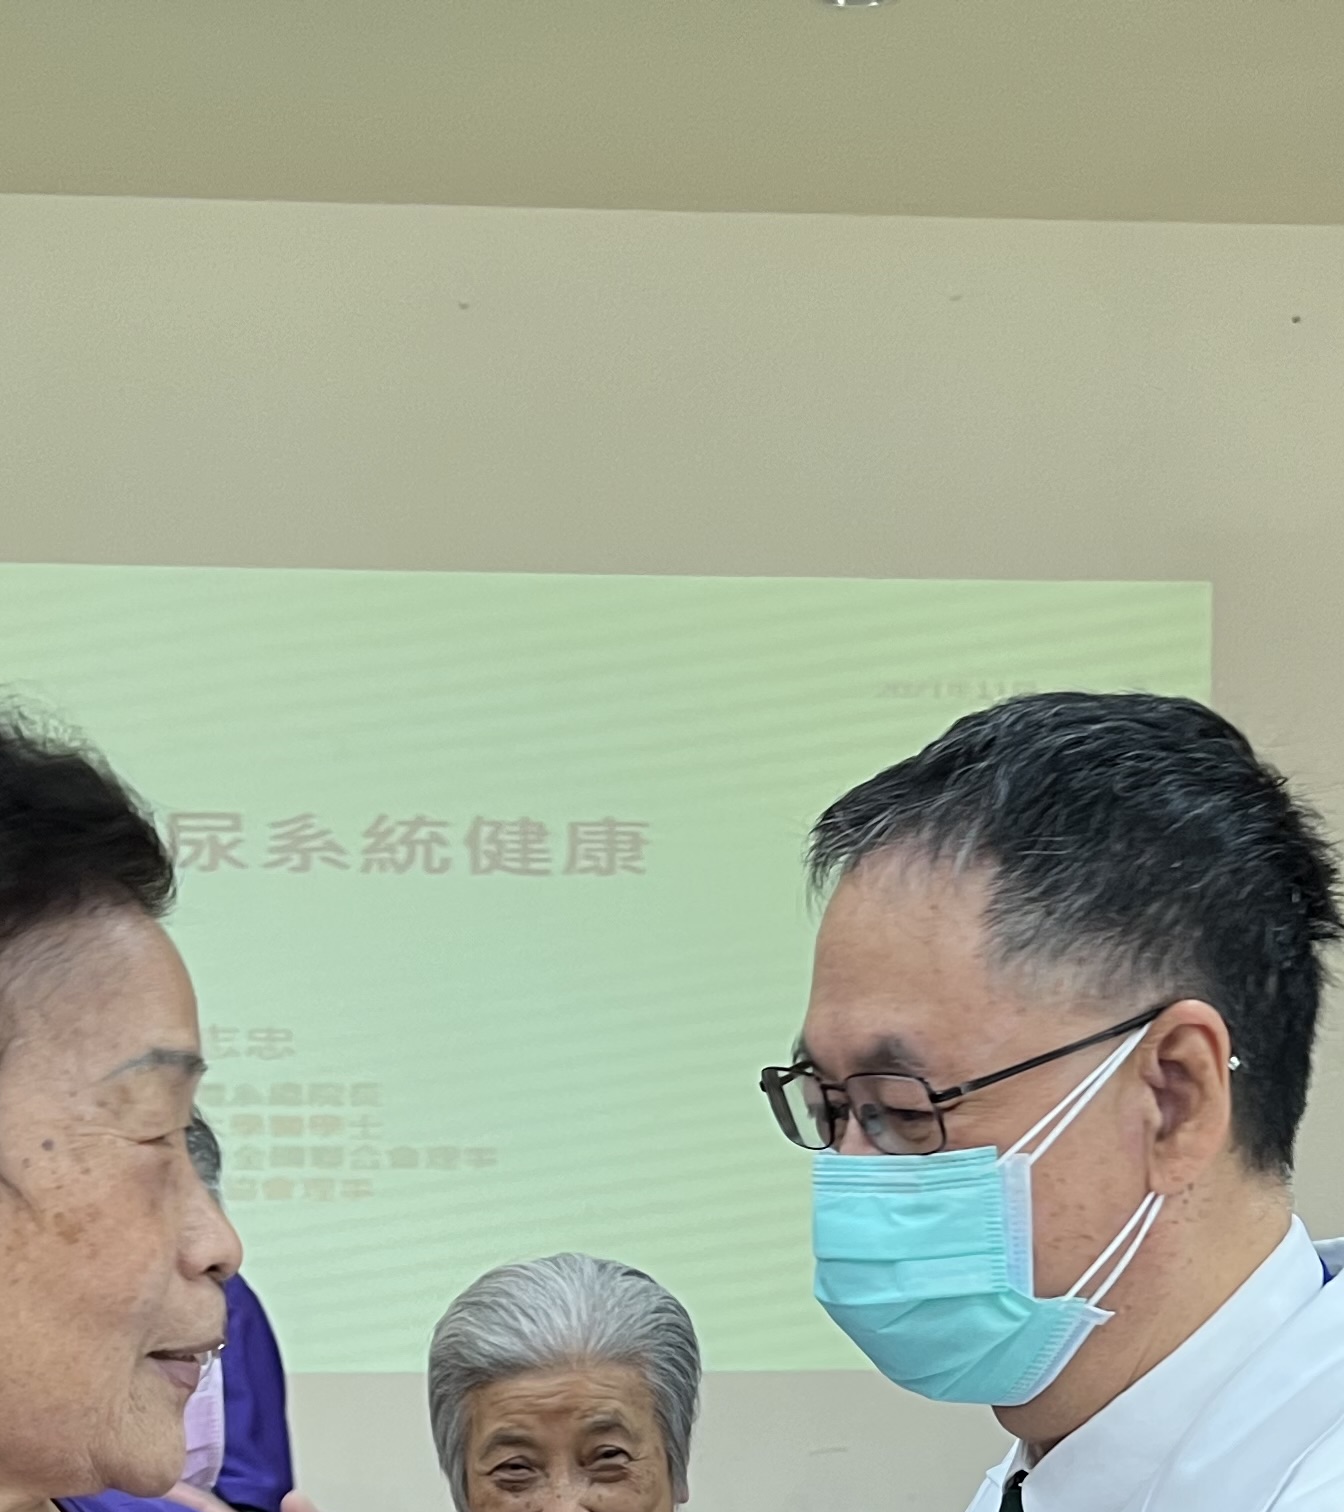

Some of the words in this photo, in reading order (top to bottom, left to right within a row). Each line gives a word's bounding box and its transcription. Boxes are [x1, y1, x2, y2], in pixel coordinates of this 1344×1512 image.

[167, 811, 652, 878] 尿系統健康
